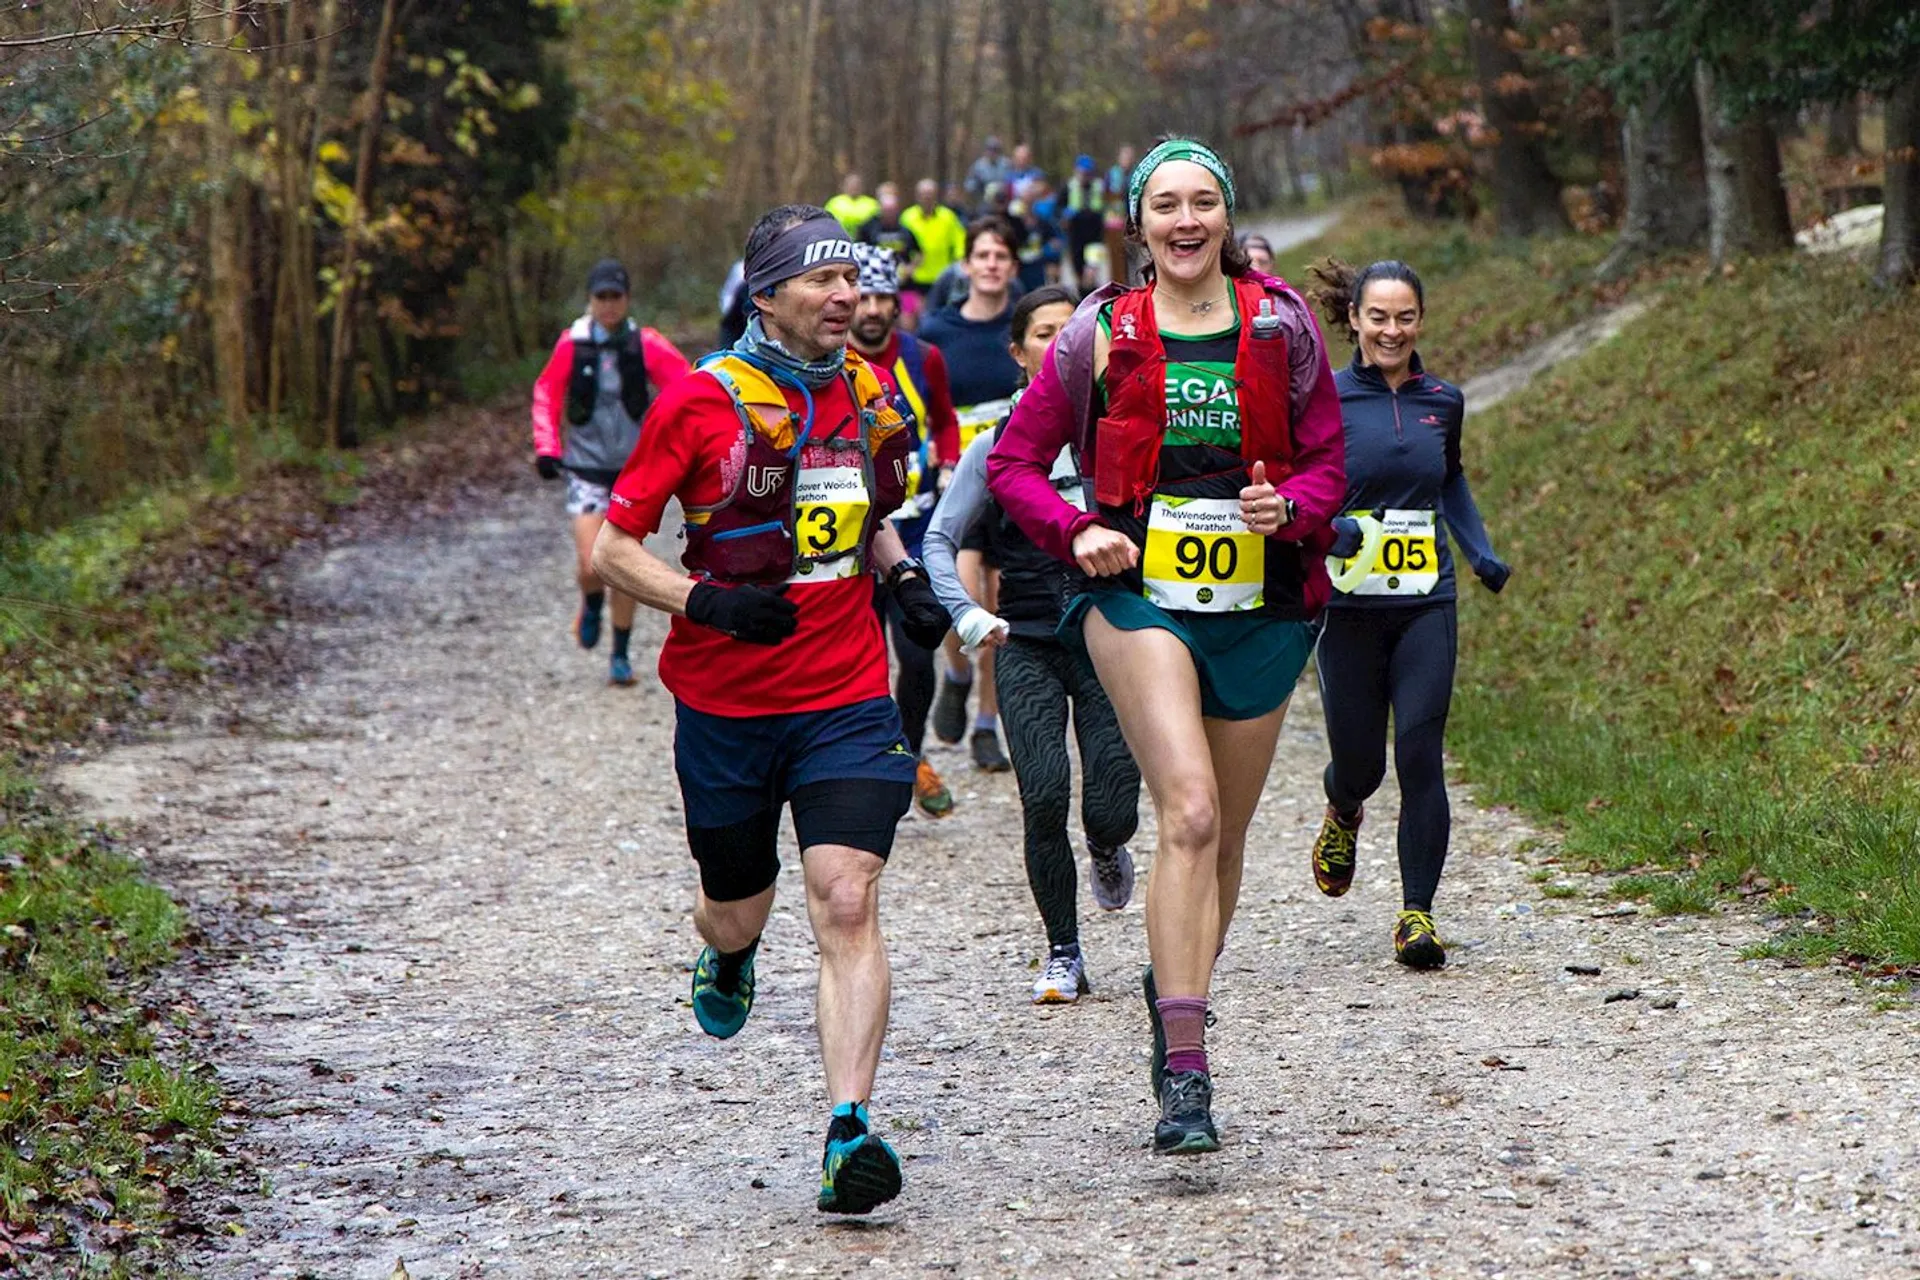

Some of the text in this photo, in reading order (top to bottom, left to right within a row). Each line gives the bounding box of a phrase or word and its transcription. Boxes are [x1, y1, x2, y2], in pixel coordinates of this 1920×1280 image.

[823, 481, 859, 490] Woods
[1185, 522, 1232, 532] Marathon
[1176, 536, 1238, 580] 90
[1371, 538, 1428, 571] 05
